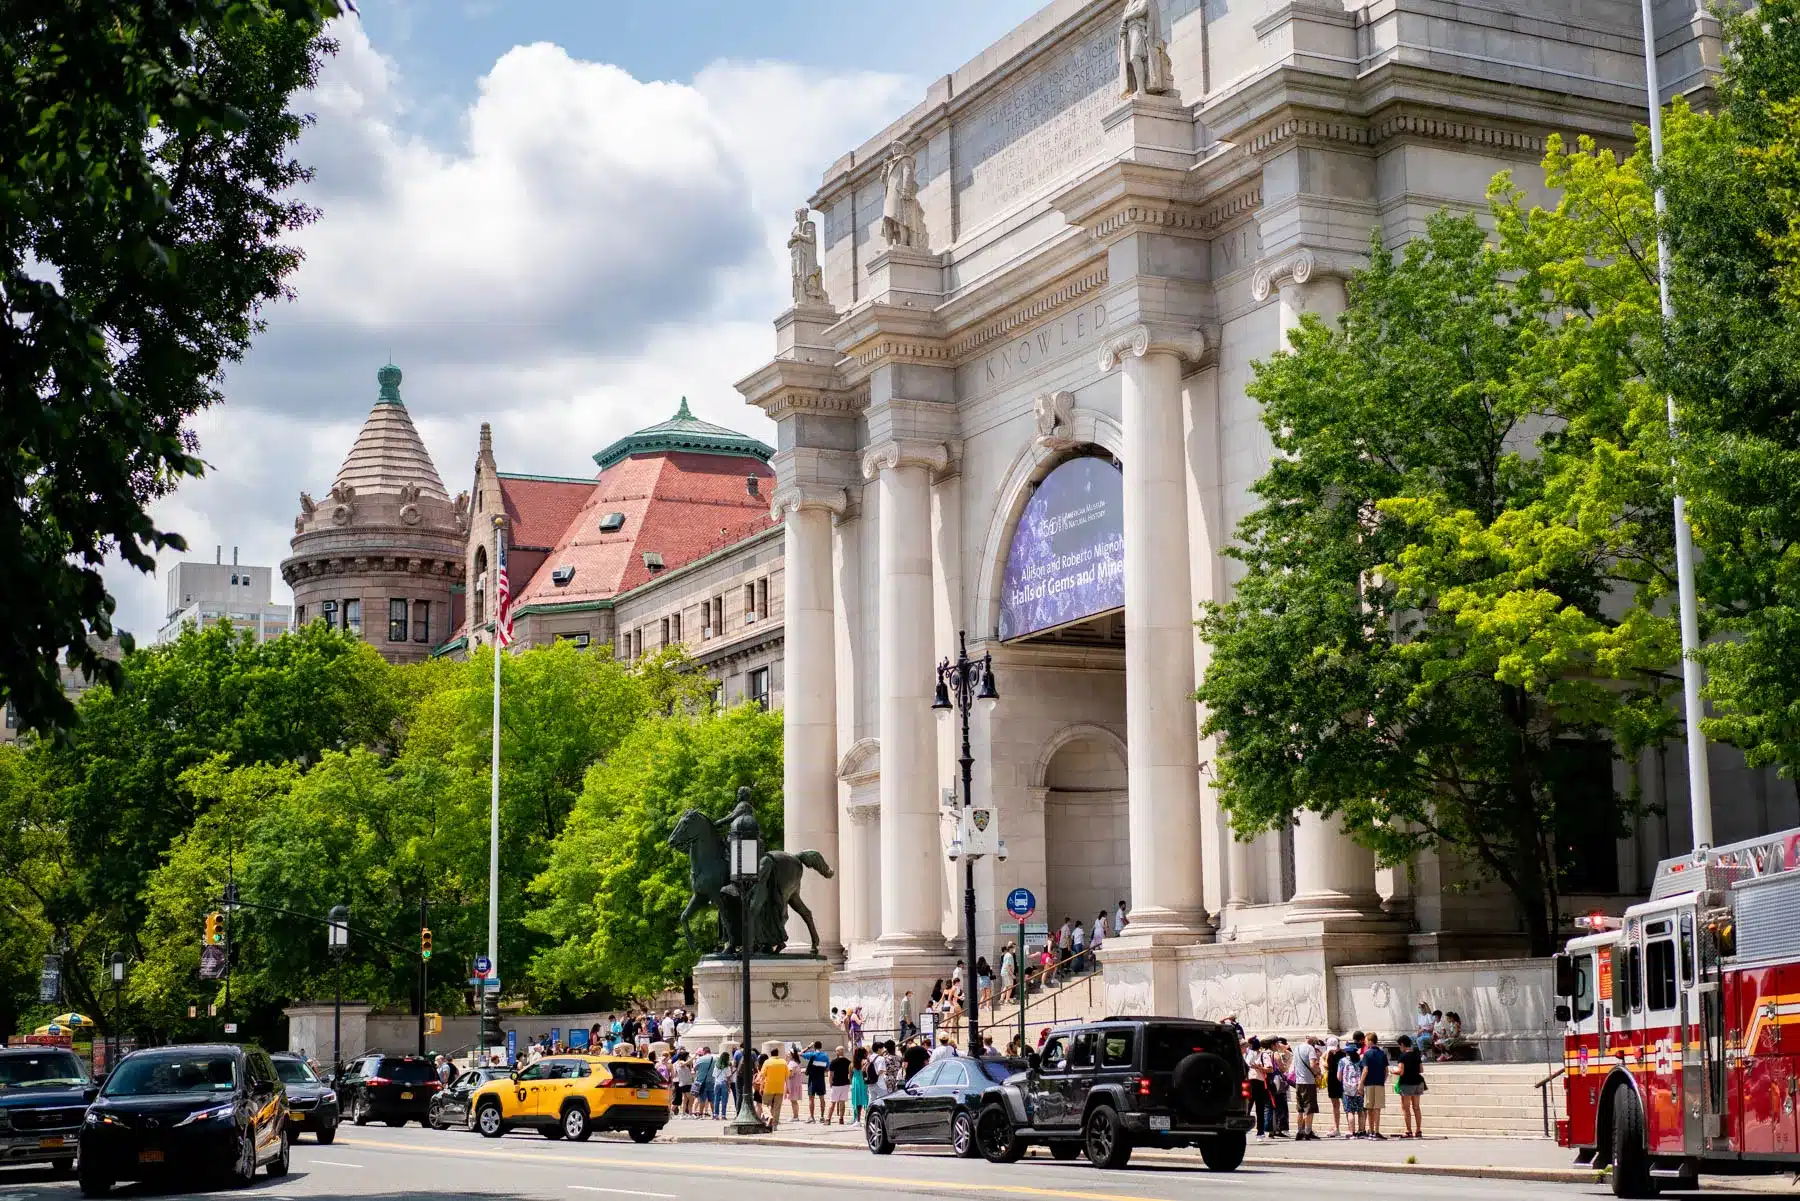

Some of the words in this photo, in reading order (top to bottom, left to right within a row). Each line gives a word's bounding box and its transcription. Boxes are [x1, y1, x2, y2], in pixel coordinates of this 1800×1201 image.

[1004, 88, 1056, 134] THEODORE
[1058, 52, 1114, 99] ROOSEVELT
[1014, 93, 1024, 110] OF
[1028, 81, 1044, 101] NEW
[1048, 64, 1070, 88] YORK
[1072, 34, 1117, 73] MEMORIAL
[986, 304, 1107, 382] KNOWLED
[1012, 584, 1034, 605] Halls
[1036, 579, 1046, 598] of
[1047, 574, 1075, 596] Gems
[1076, 562, 1095, 586] and
[1098, 559, 1125, 579] Mine
[1021, 562, 1046, 582] Allison
[1047, 559, 1060, 572] and
[1062, 546, 1092, 569] Roberto
[1656, 1039, 1672, 1075] 25
